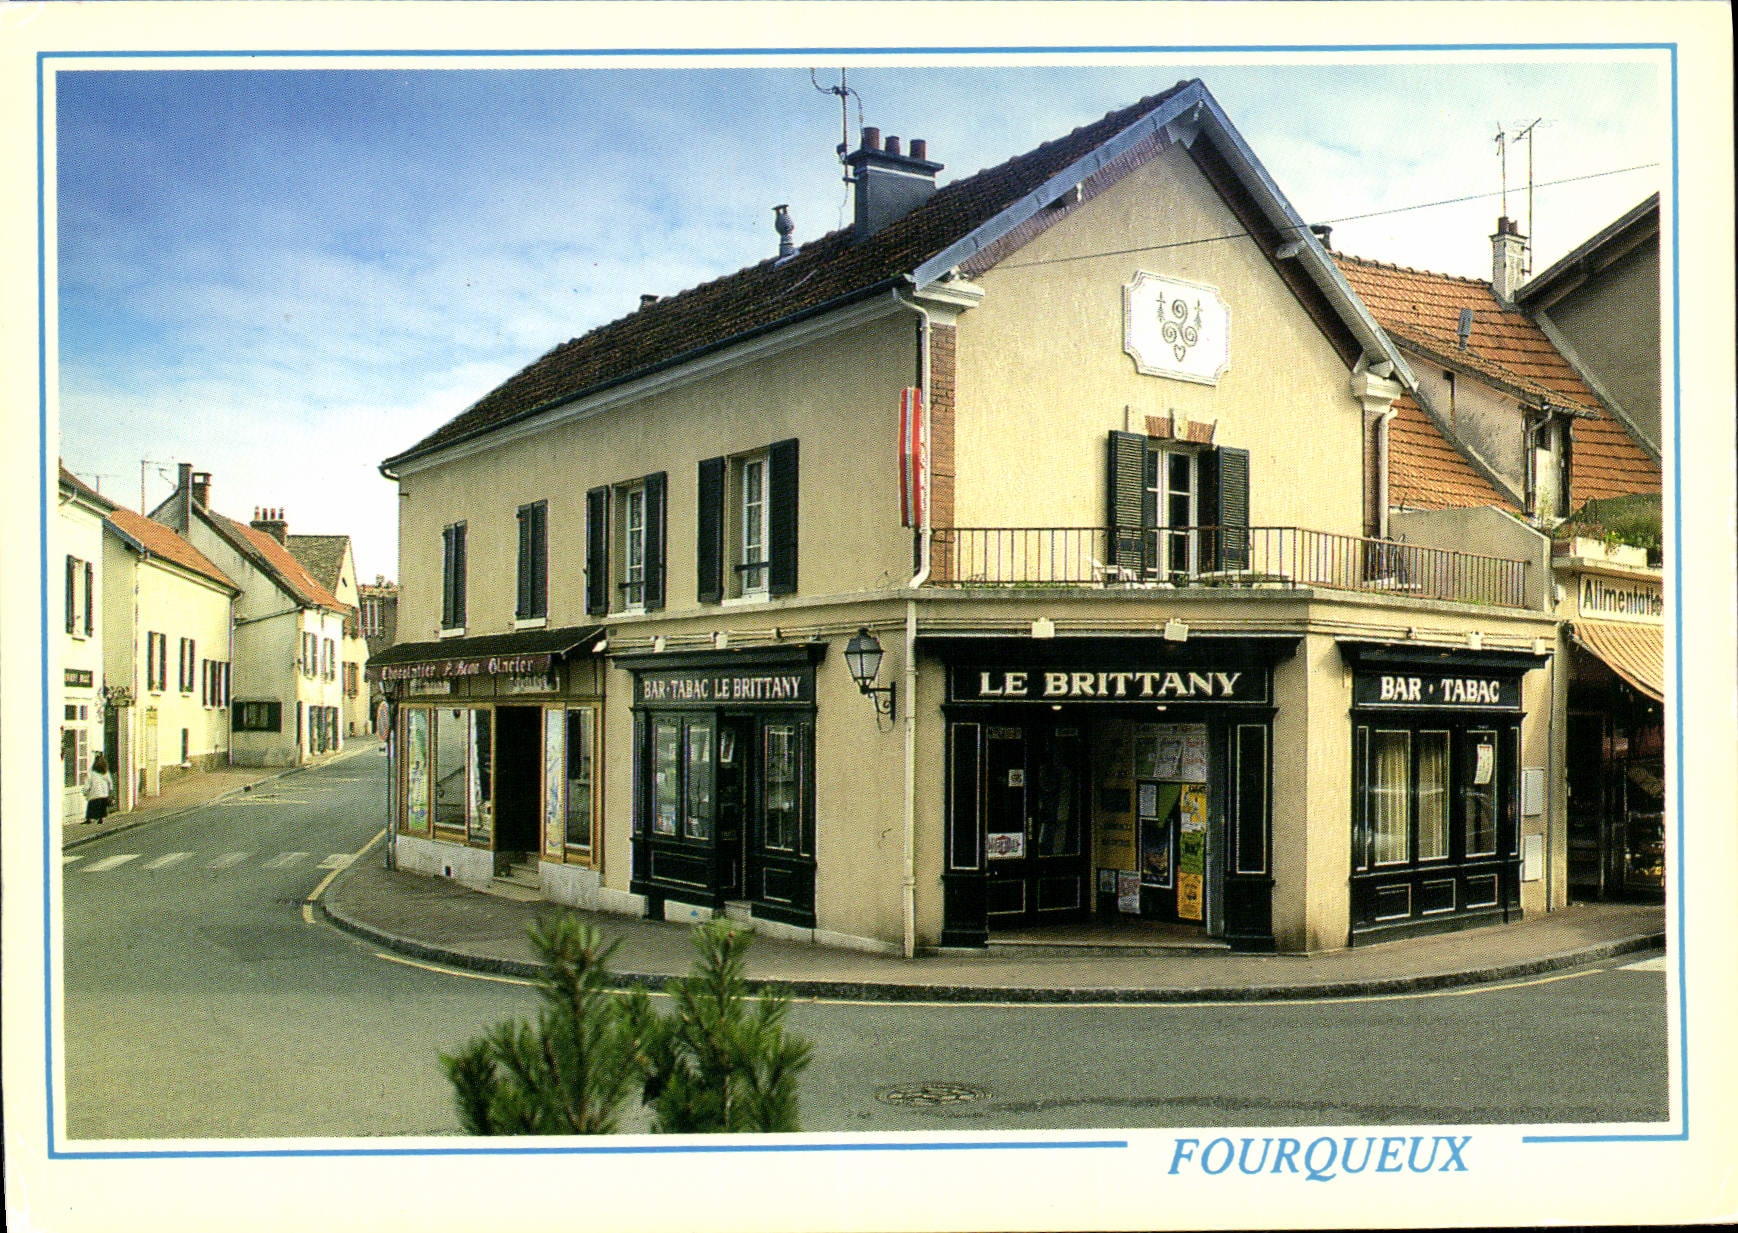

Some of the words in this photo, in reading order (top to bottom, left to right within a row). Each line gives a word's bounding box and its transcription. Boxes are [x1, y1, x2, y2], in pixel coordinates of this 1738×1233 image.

[714, 678, 730, 699] LE
[733, 676, 801, 699] BRITTANY
[979, 671, 1029, 697] LE
[1042, 671, 1242, 697] BRITTANY
[1380, 676, 1421, 701] BAR
[1440, 678, 1500, 703] TABAC
